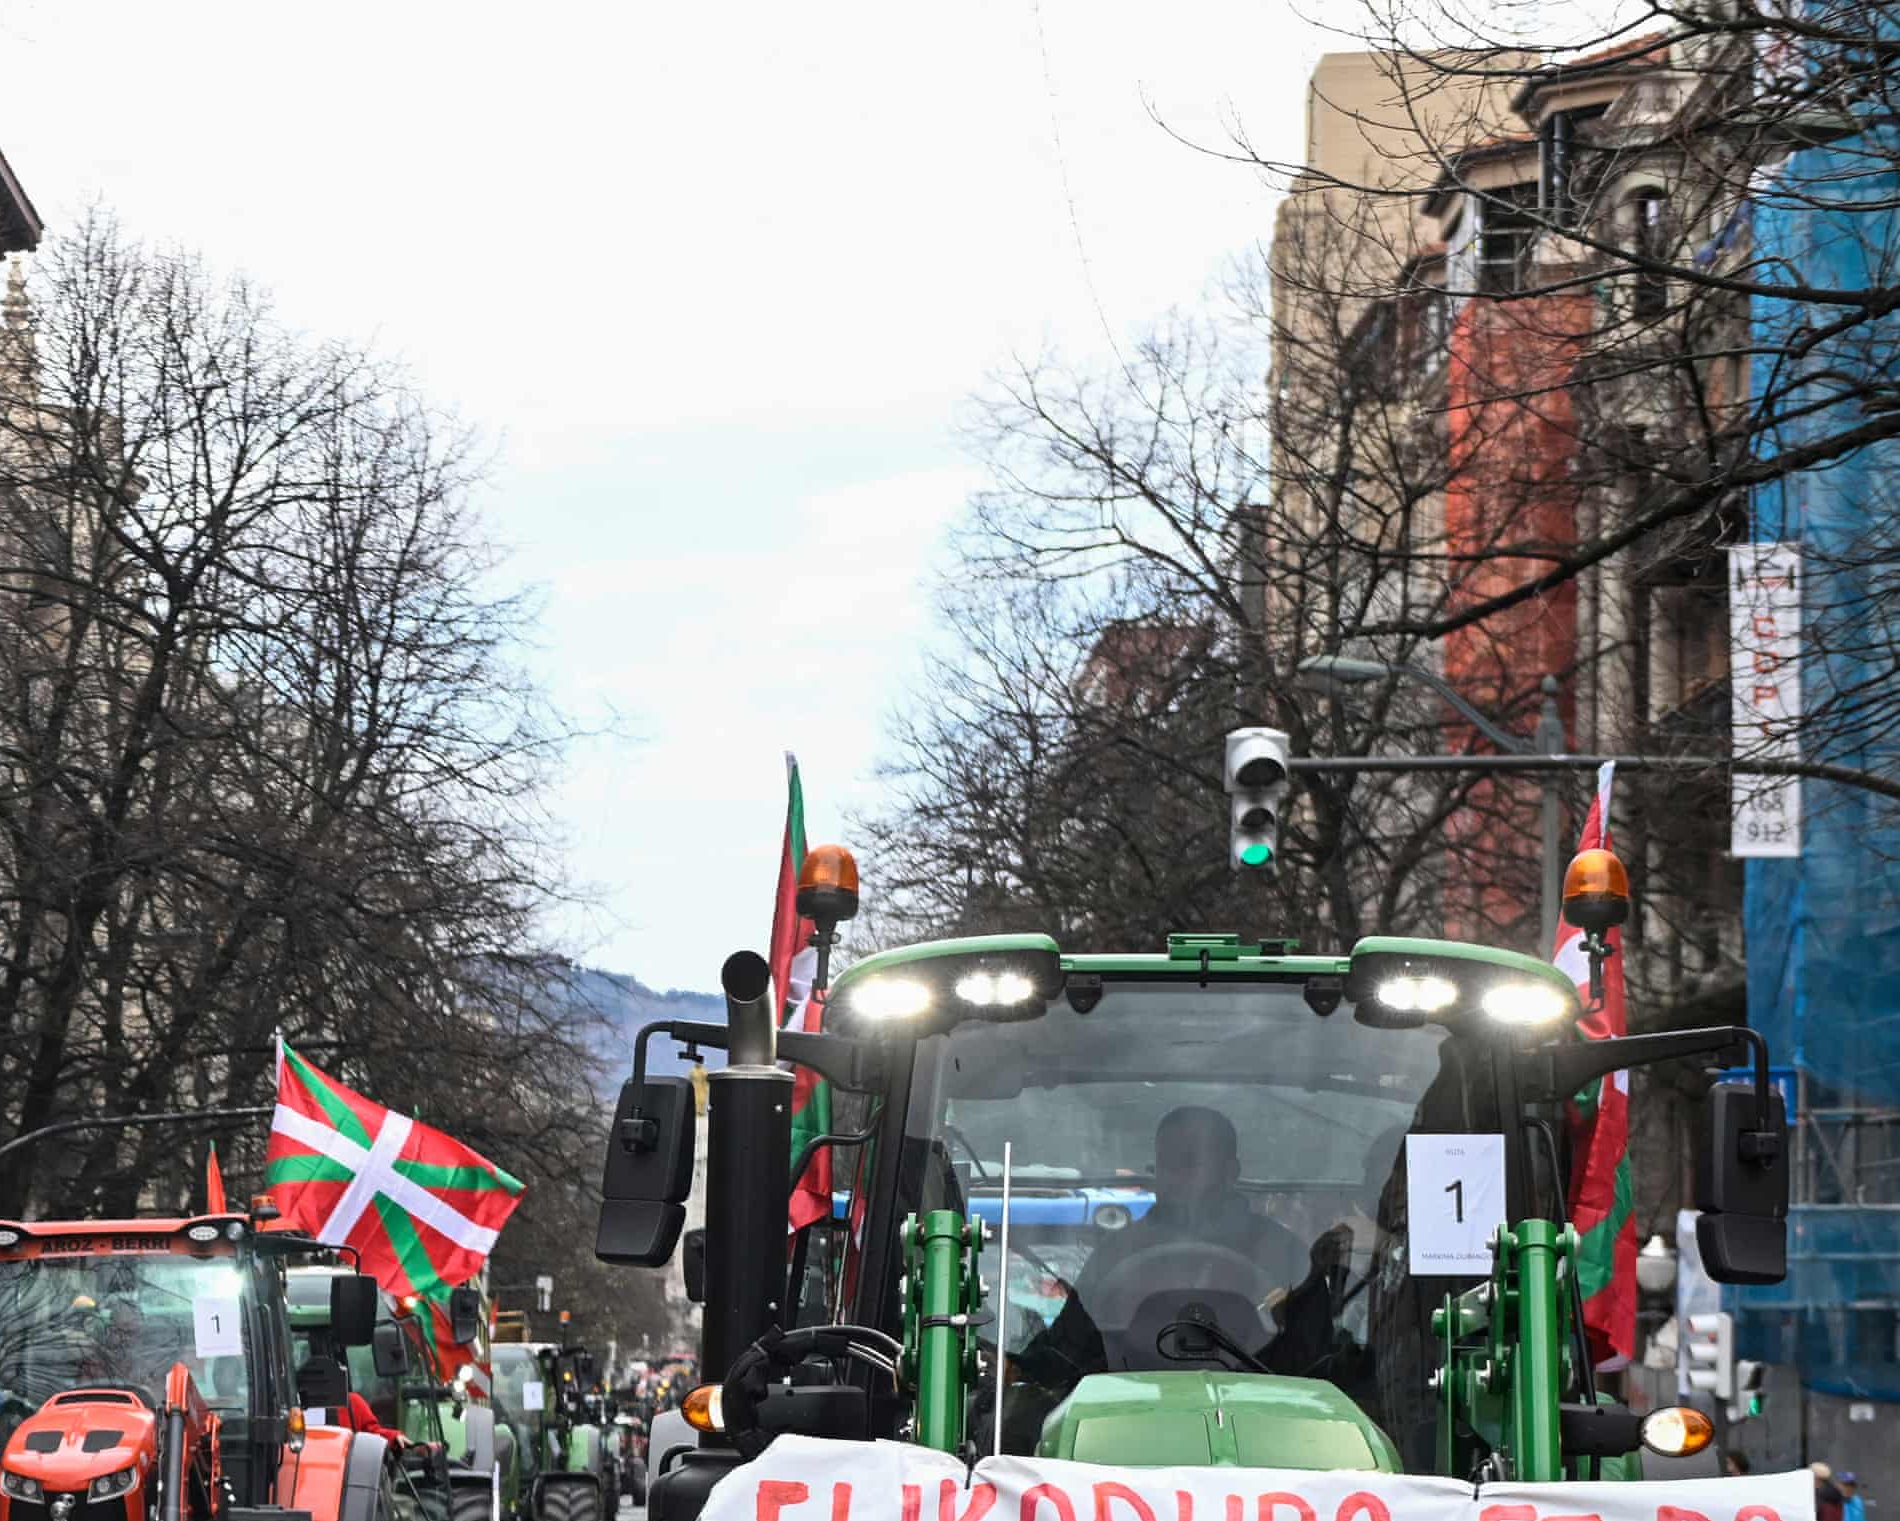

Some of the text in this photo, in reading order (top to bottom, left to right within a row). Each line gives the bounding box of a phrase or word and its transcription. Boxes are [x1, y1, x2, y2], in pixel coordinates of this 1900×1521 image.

[1444, 1179, 1464, 1224] 1
[41, 1238, 95, 1252] AROZ
[111, 1237, 172, 1251] BERRI
[210, 1313, 221, 1335] 1
